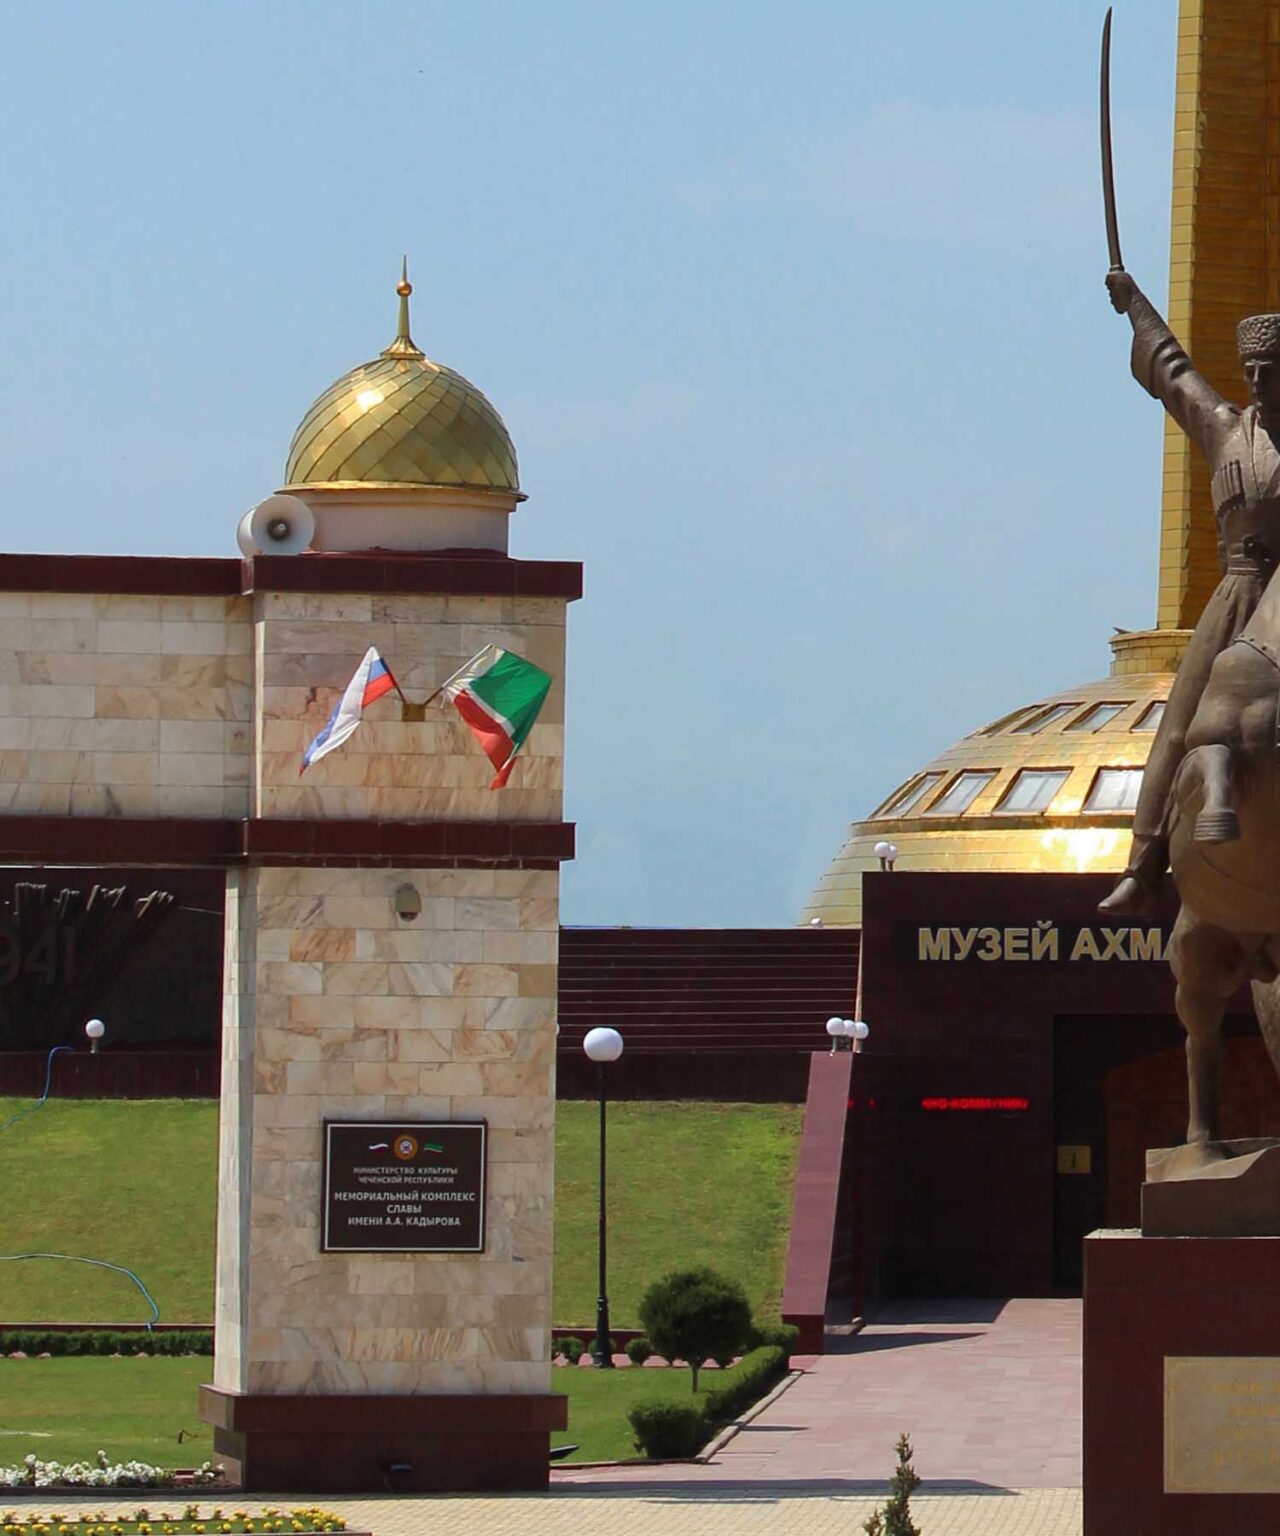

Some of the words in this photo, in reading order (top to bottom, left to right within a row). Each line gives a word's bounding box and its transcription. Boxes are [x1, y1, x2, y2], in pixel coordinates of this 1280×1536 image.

[917, 919, 1059, 961] МУЗЕЙ
[353, 1167, 415, 1175] МИНИСТЕРСТВО
[418, 1167, 458, 1175] КУЛЬТУРЫ
[358, 1175, 402, 1184] ЧЕЧЕНСКОЙ
[404, 1176, 454, 1184] РЕСПУБЛИКИ
[334, 1190, 419, 1201] МЕМОРИАЛЬНЫЙ
[421, 1192, 475, 1201] КОМПЛЕКС
[387, 1204, 422, 1213] СЛАВЫ
[348, 1217, 383, 1226] ИМЕНИ
[385, 1217, 404, 1226] А.А.
[406, 1217, 461, 1227] КАДЫРОВА
